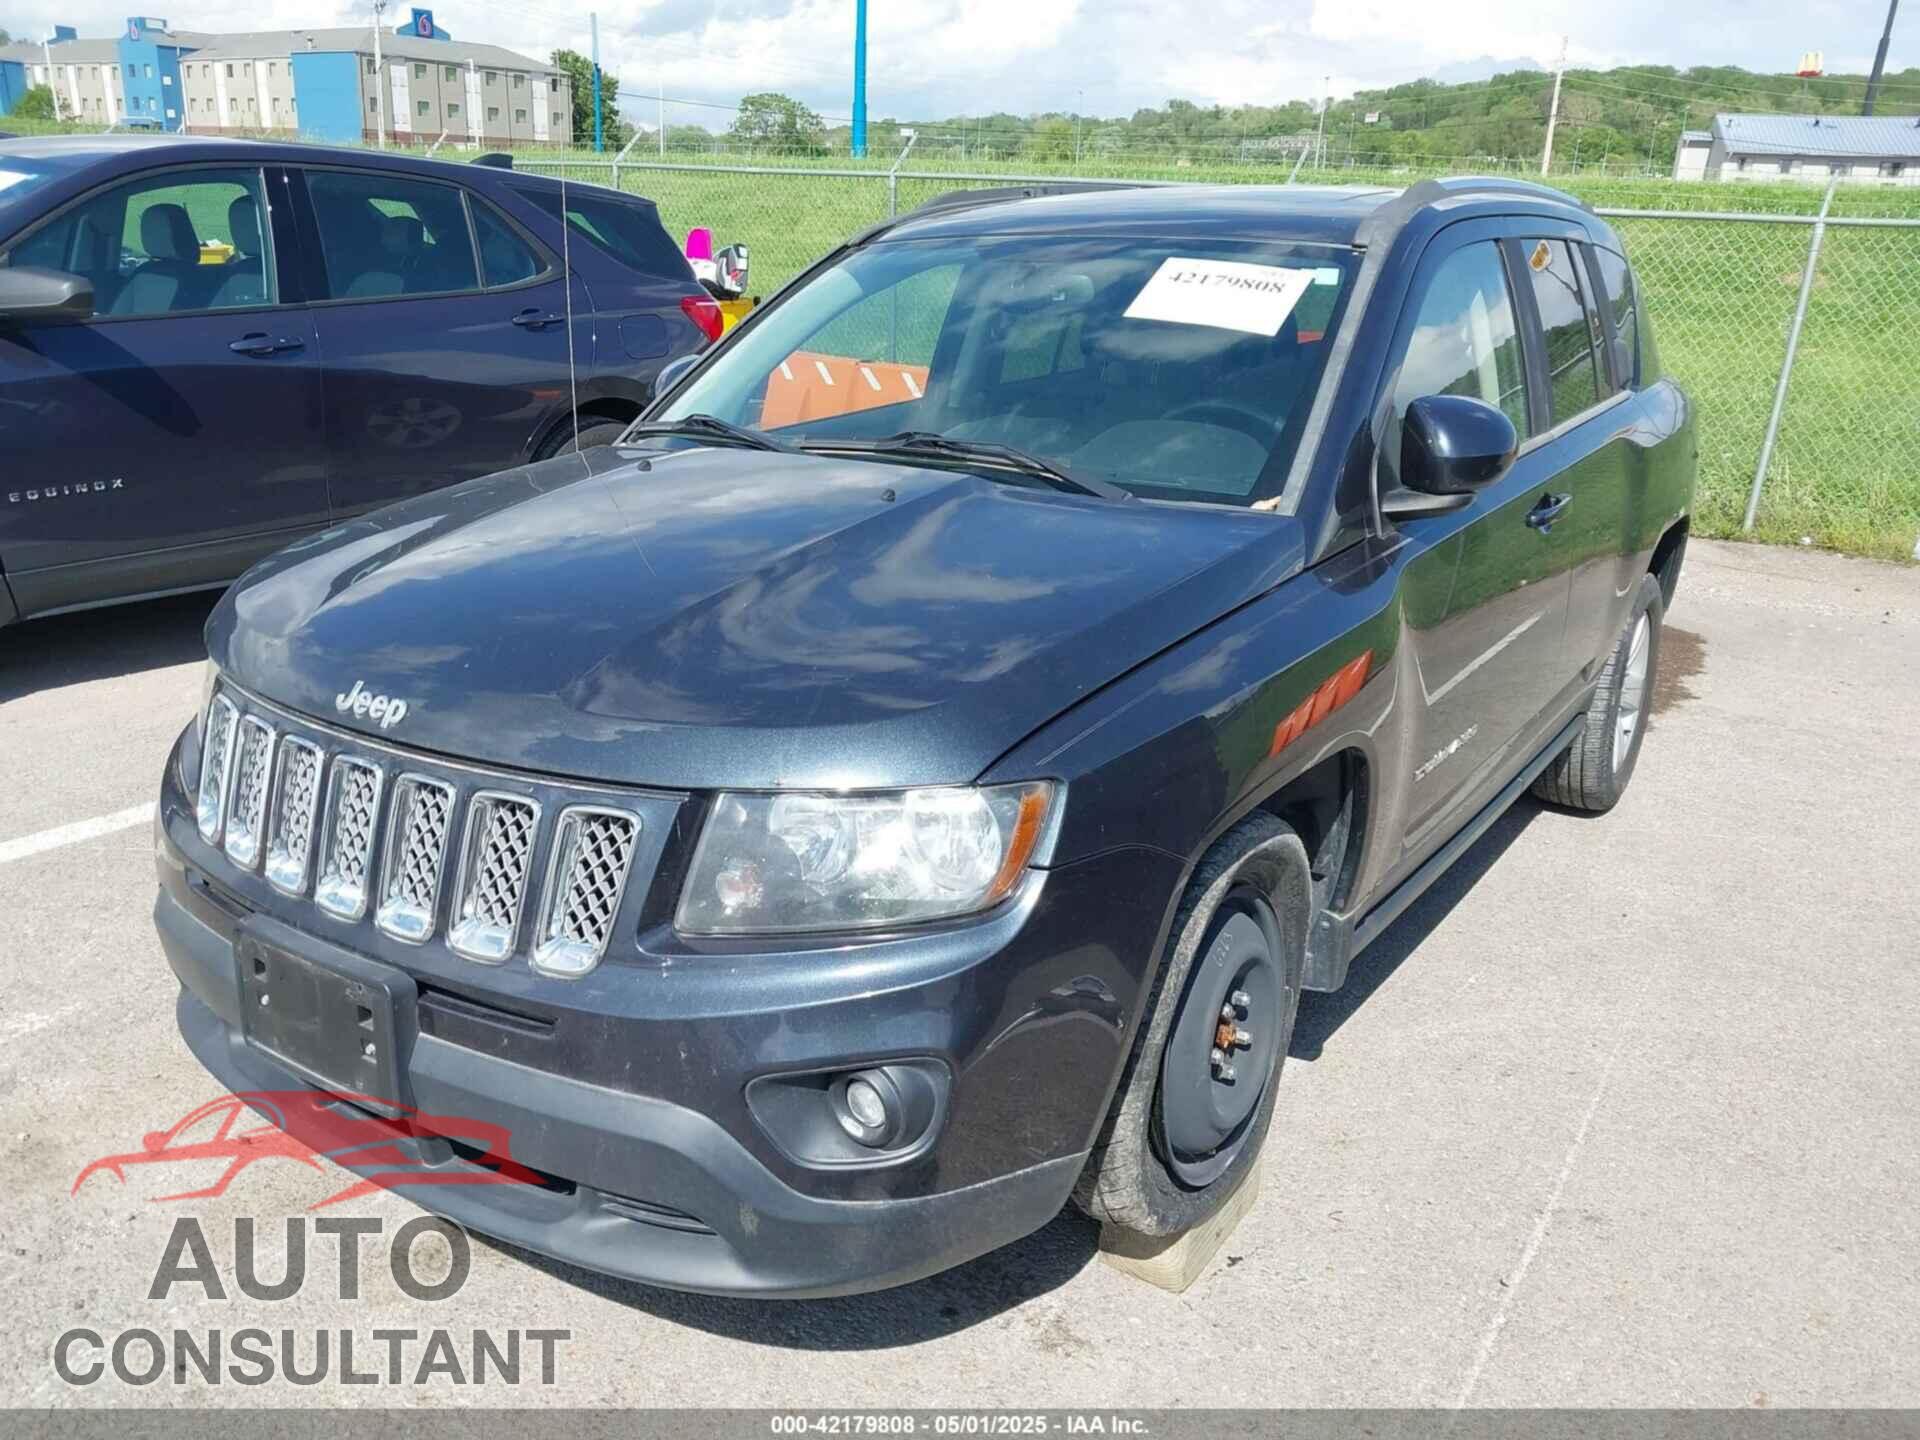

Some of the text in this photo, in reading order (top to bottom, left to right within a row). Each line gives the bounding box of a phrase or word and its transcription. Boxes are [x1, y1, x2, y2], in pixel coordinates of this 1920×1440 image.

[1168, 271, 1286, 294] 42179808
[8, 478, 124, 503] EQUINOX
[335, 679, 408, 729] Jeep
